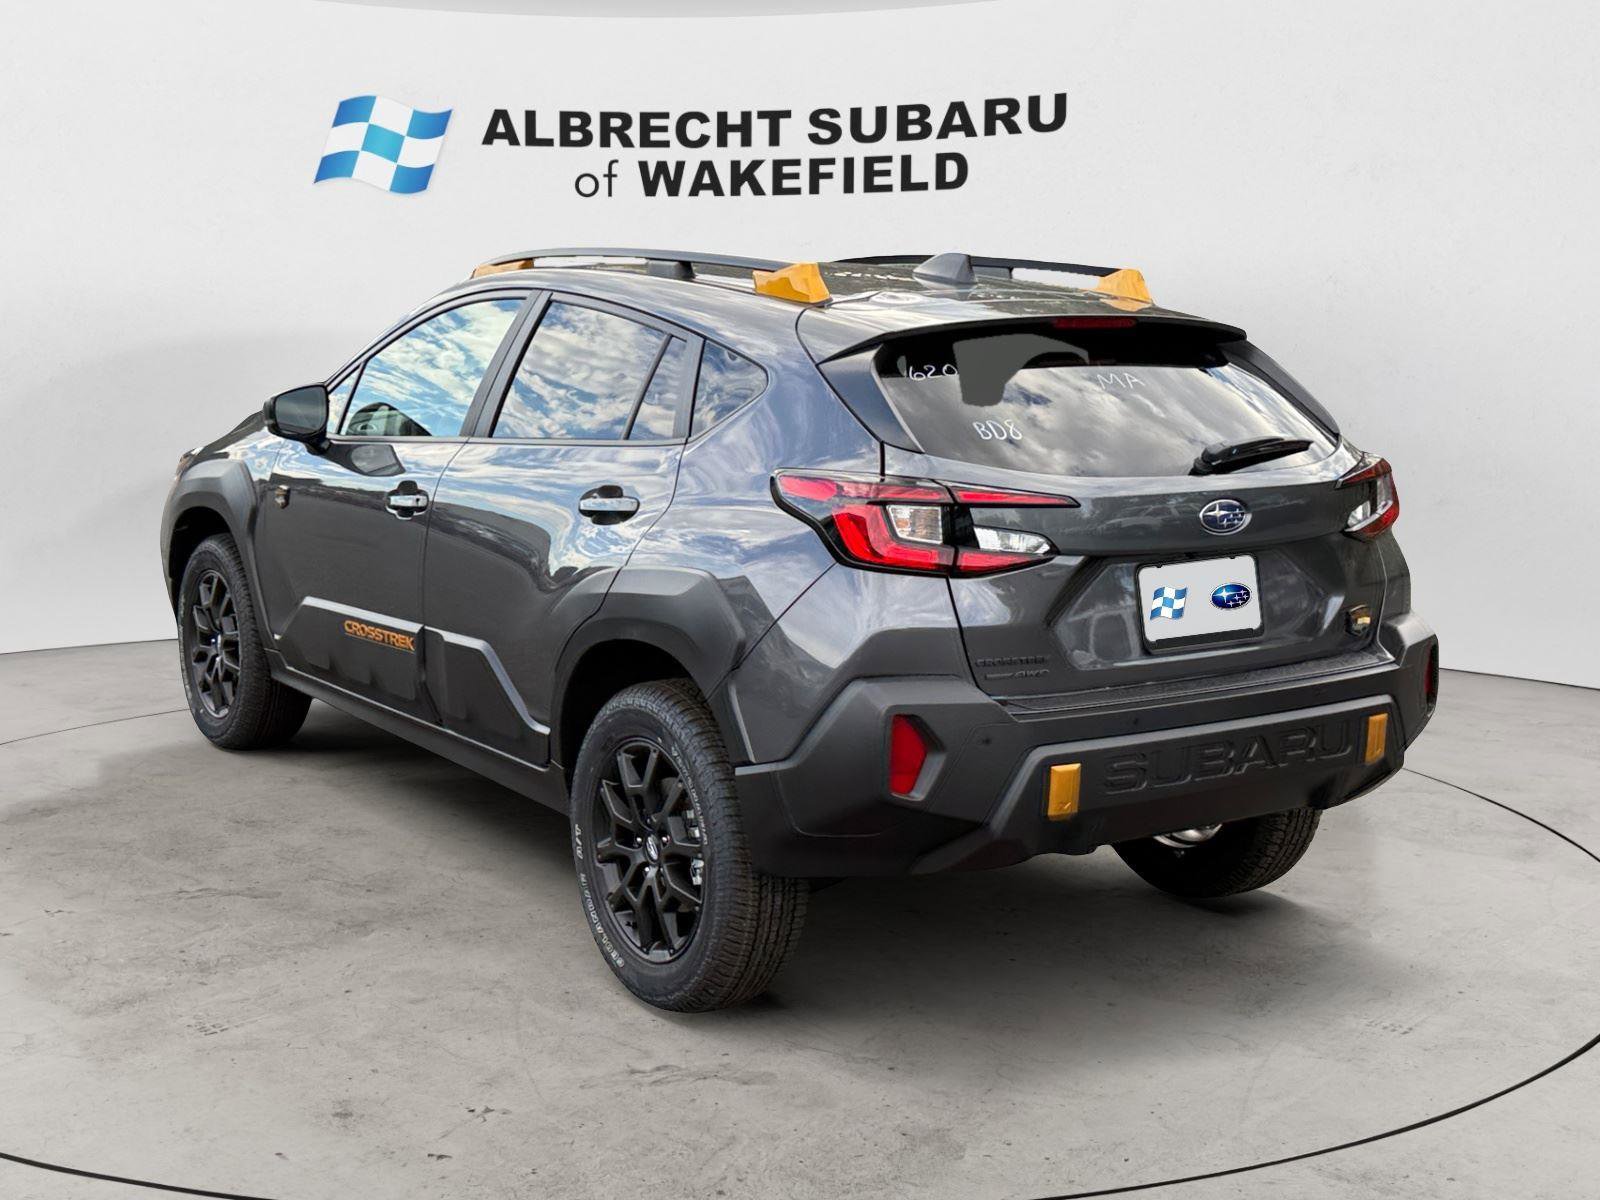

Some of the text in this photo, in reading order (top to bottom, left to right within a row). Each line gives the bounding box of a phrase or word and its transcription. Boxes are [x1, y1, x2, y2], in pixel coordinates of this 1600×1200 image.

[482, 93, 1066, 148] ALBRECHT SUBARU
[575, 153, 968, 197] of WAKEFIELD
[1096, 372, 1146, 390] MA
[344, 619, 415, 652] CROSSTREK
[1103, 720, 1352, 797] SUBARU
